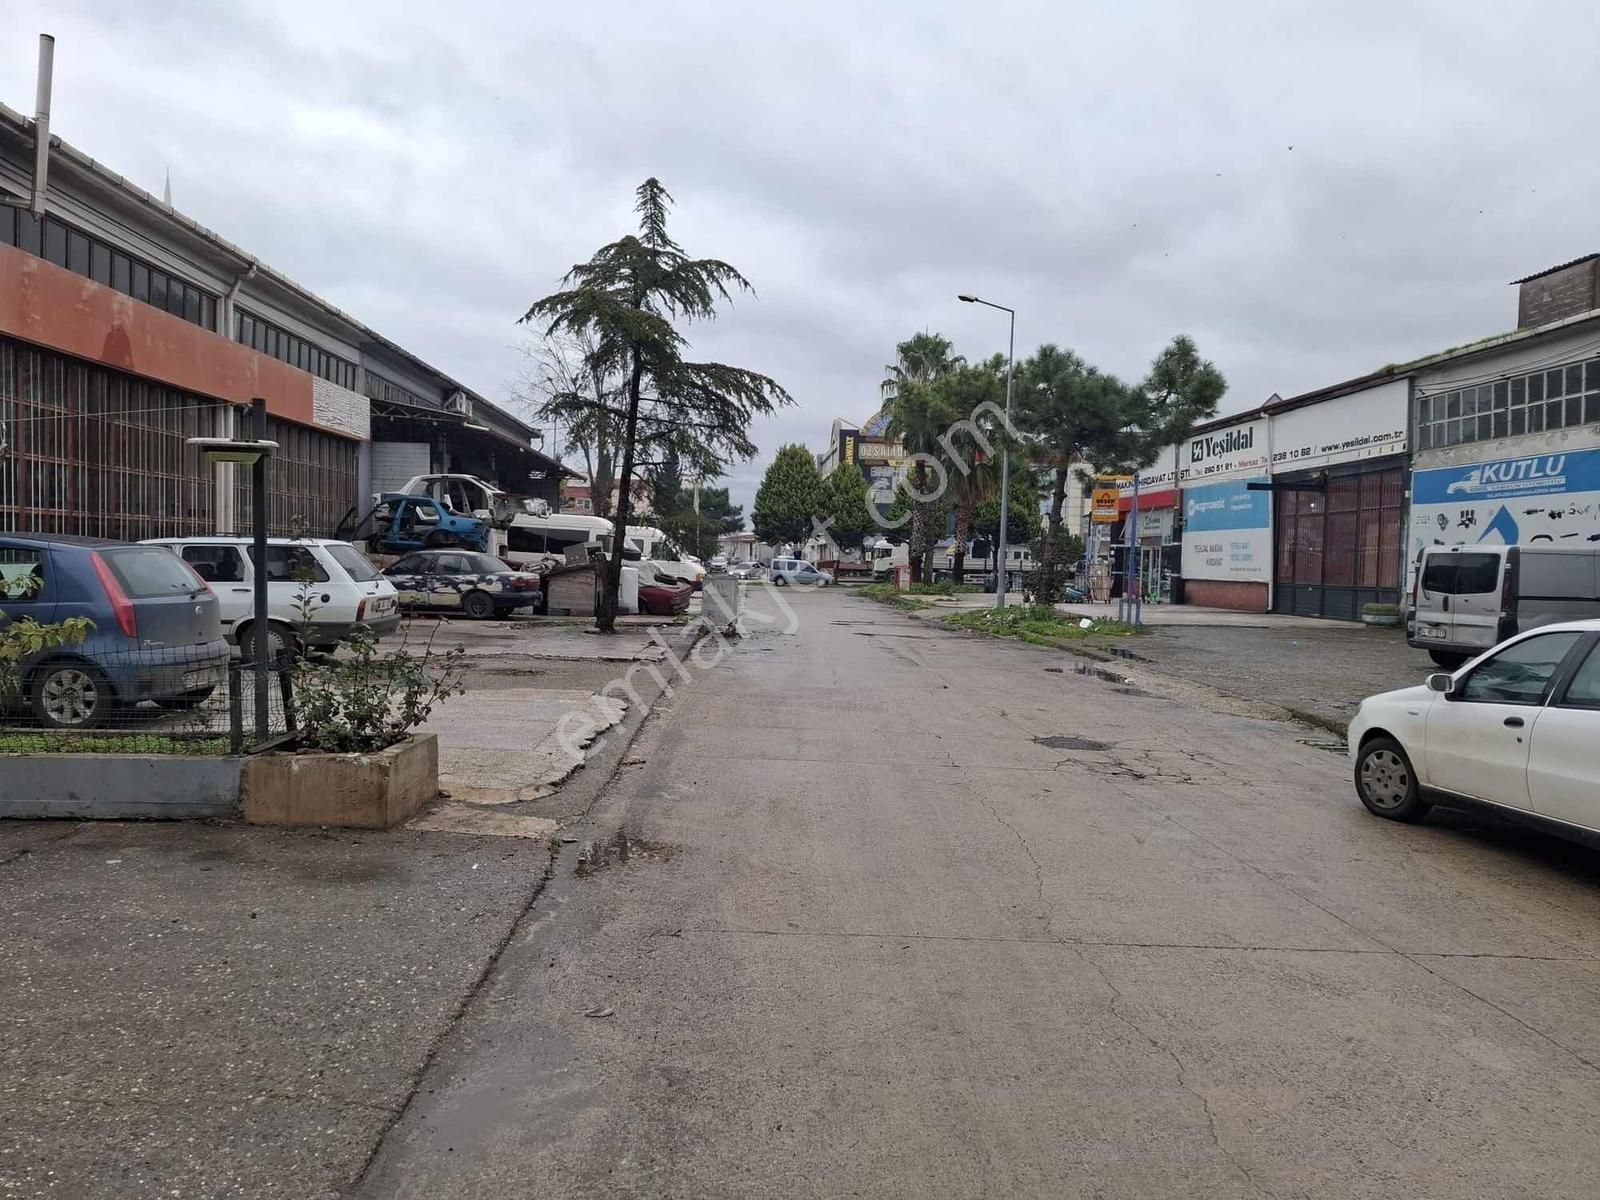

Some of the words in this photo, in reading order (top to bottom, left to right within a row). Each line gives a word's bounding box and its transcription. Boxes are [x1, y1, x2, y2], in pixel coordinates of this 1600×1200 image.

[1205, 426, 1253, 460] Yeşildal
[1289, 449, 1299, 459] 10
[1321, 430, 1403, 453] www.yesildal.com.tr
[1481, 455, 1567, 483] KUTLU
